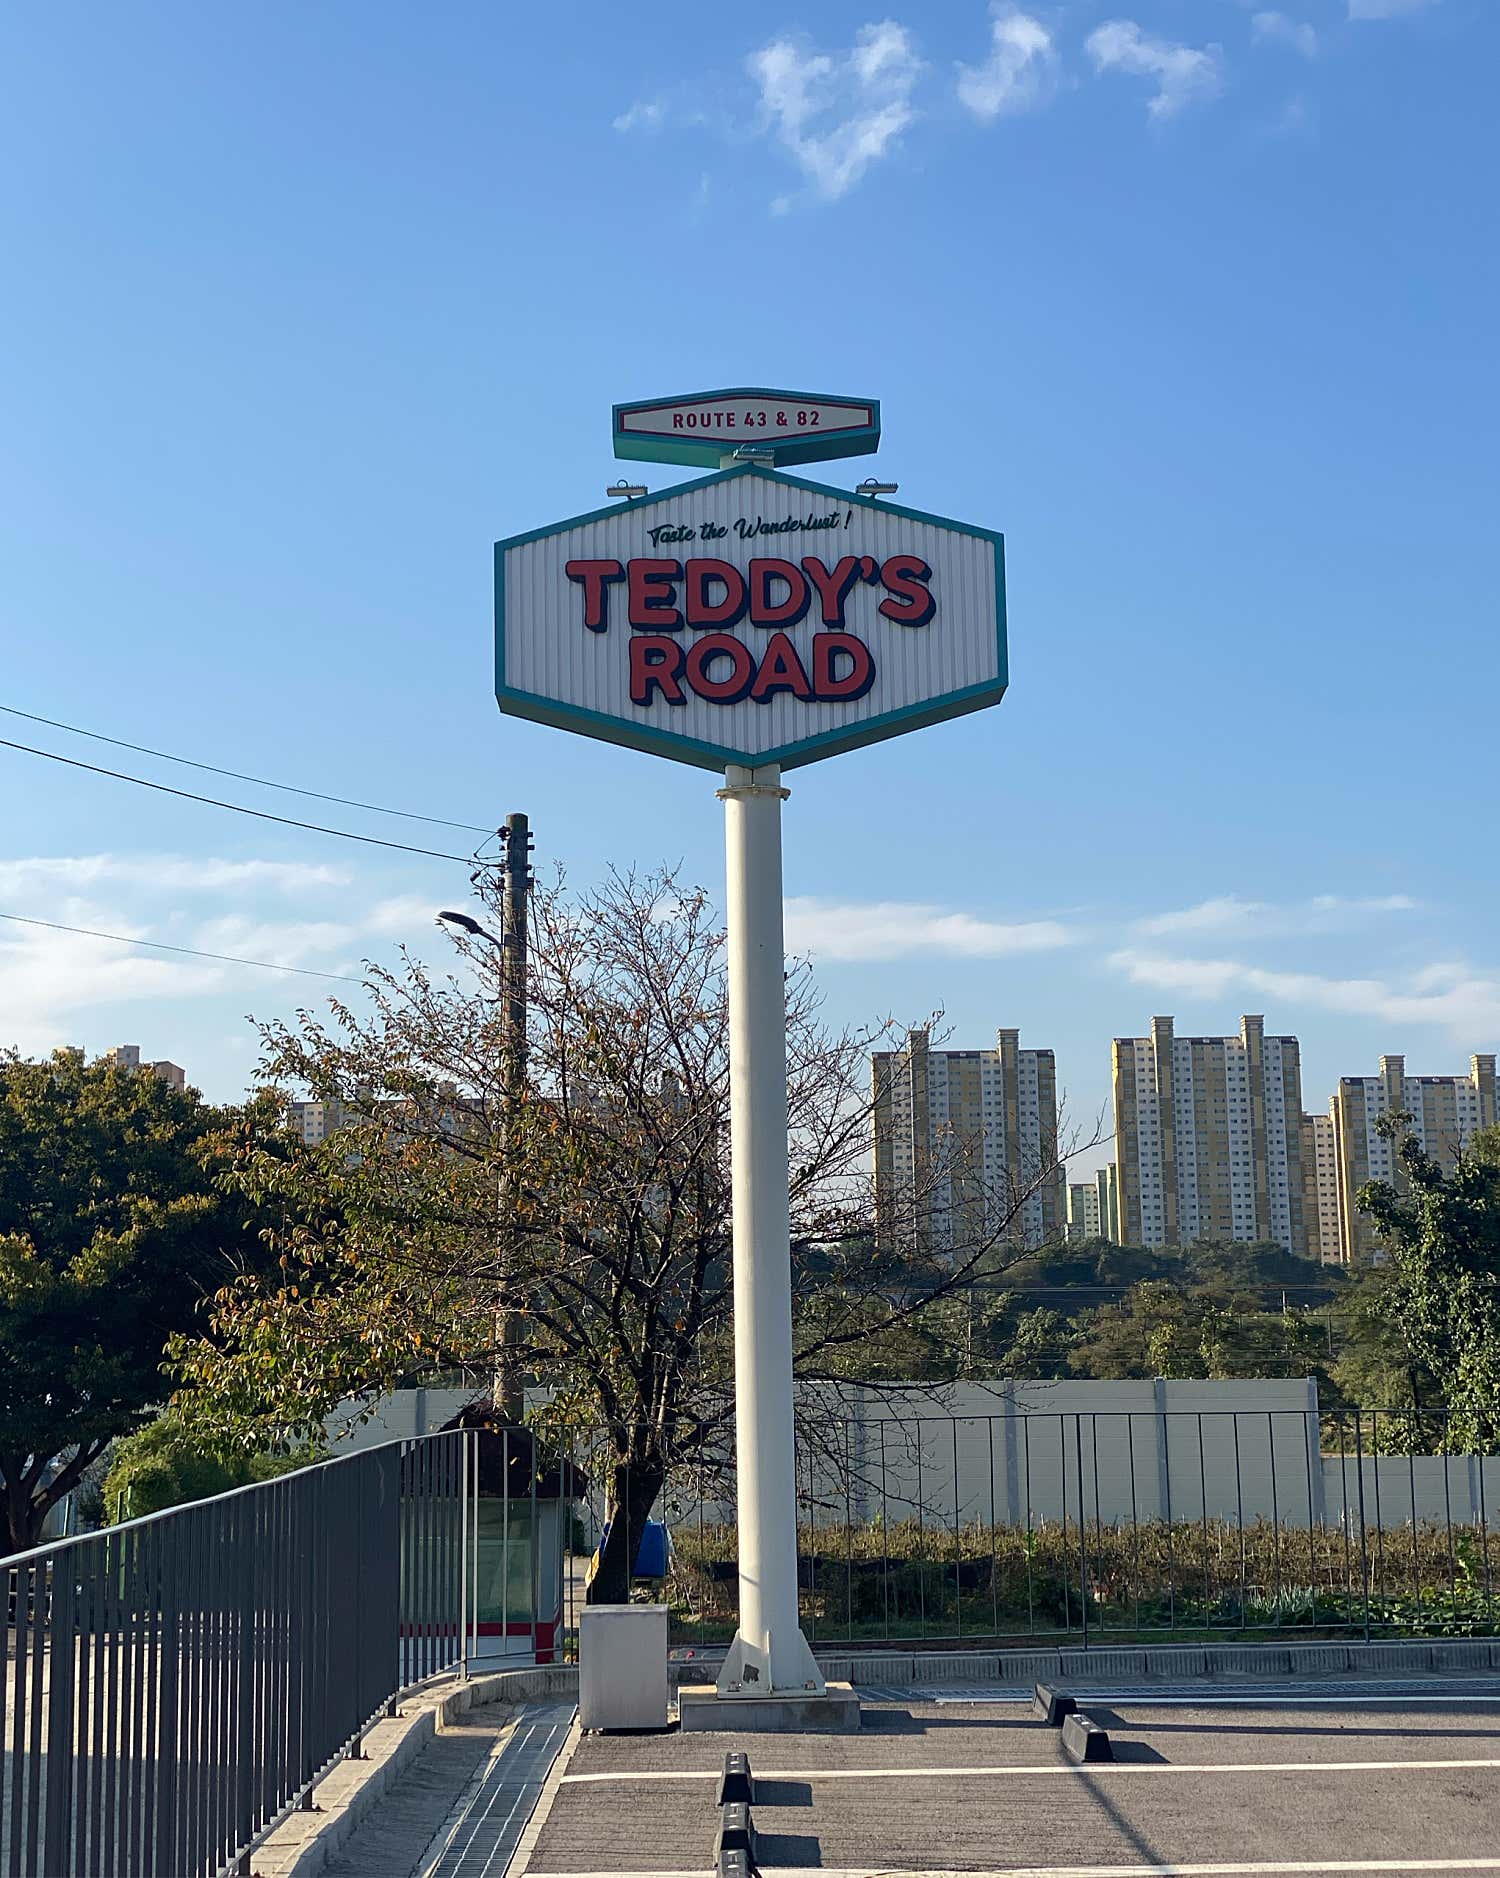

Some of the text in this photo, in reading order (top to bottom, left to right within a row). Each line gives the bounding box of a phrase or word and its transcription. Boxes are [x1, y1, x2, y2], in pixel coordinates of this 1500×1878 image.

[672, 411, 820, 428] ROUTE 43 & 82
[647, 524, 697, 548] Taste
[700, 521, 729, 541] the
[565, 555, 936, 632] TEDDY'S
[629, 632, 875, 706] ROAD
